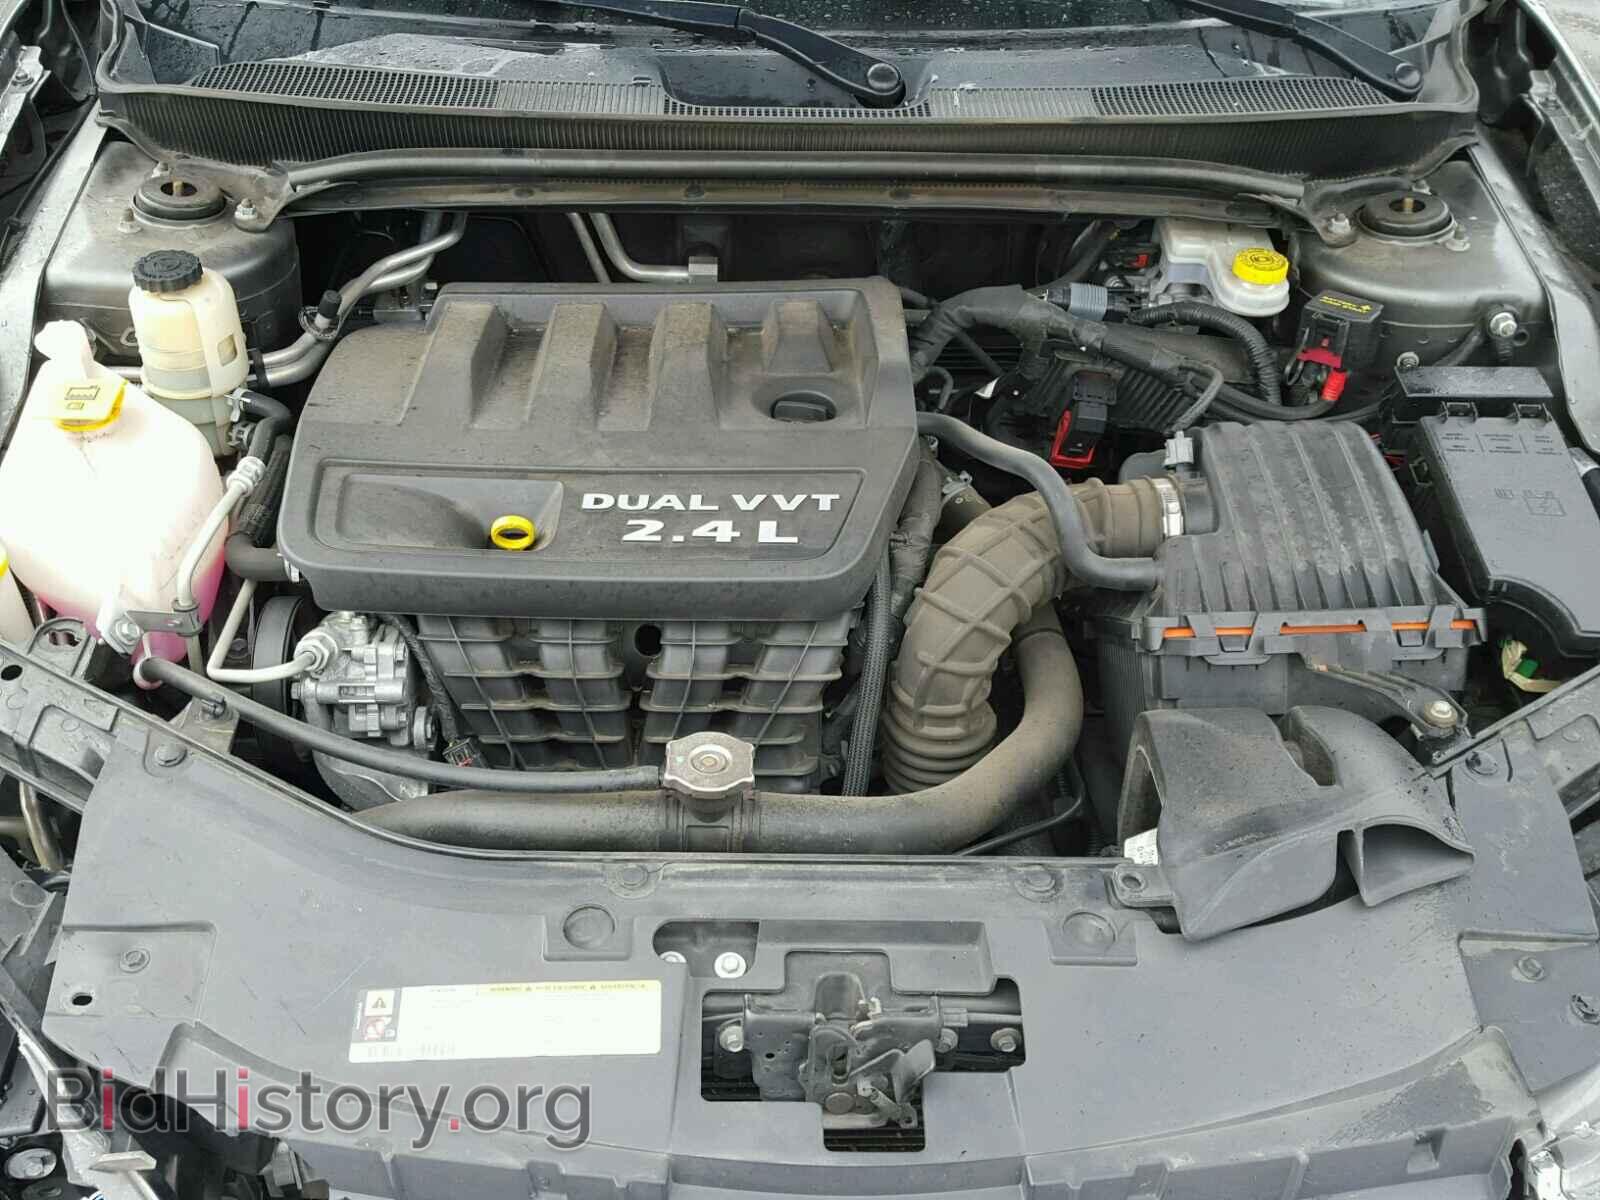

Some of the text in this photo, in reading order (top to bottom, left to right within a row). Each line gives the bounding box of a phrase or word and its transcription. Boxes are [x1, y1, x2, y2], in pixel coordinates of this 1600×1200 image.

[581, 493, 841, 511] DUAL VVT
[621, 519, 799, 544] 2.4 L
